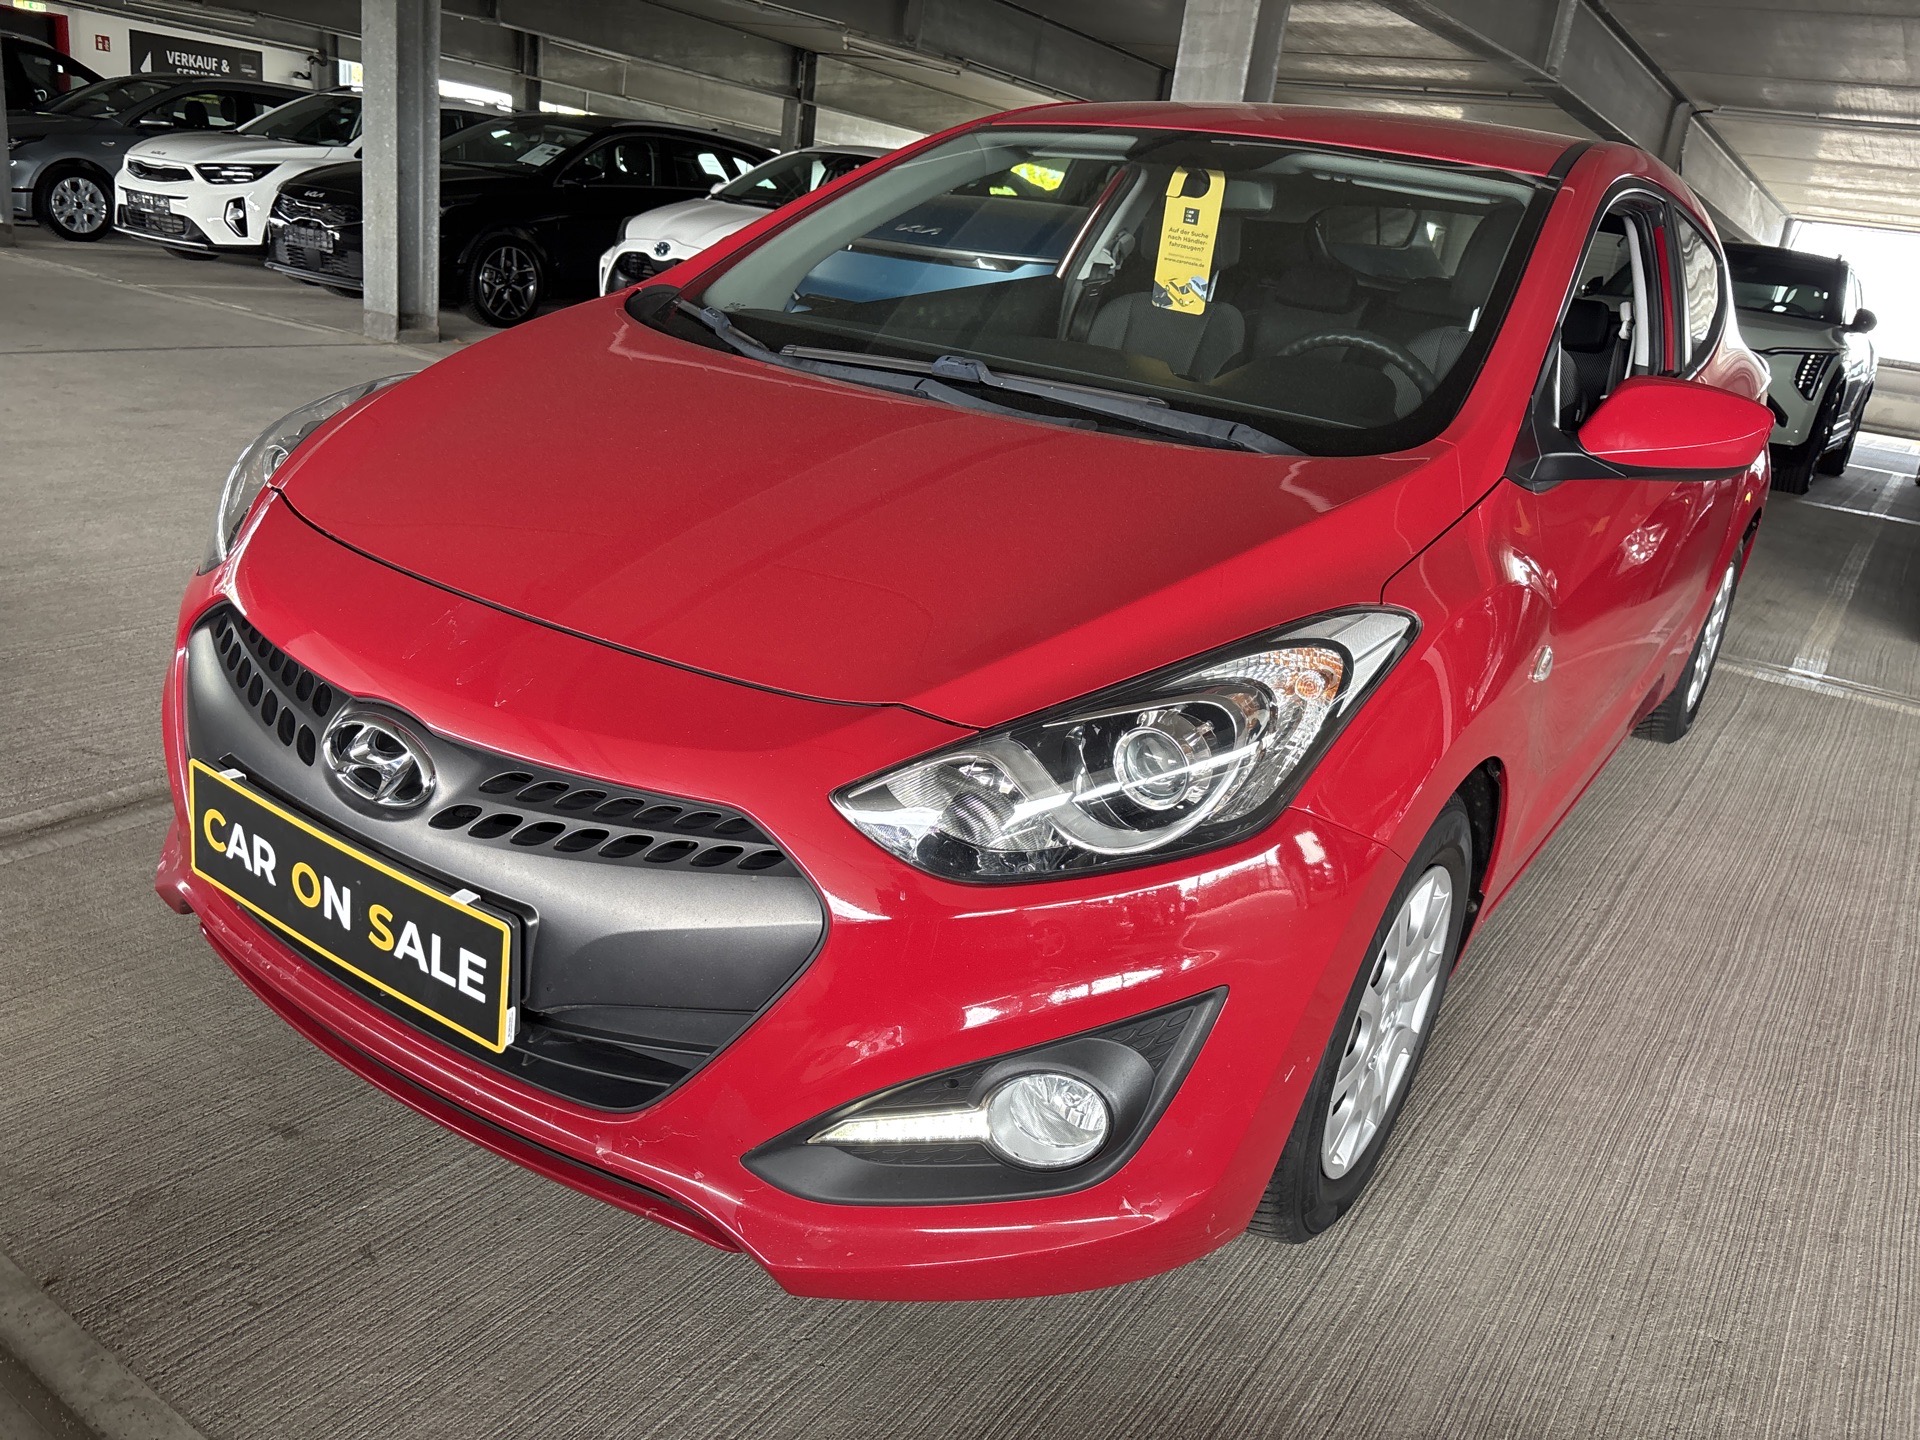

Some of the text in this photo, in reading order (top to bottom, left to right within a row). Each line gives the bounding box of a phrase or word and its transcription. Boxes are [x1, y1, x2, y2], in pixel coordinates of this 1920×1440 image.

[166, 50, 218, 71] VERKAUF
[221, 59, 230, 73] &
[1191, 231, 1209, 239] Suche
[1169, 241, 1205, 252] fahrzeugen?
[203, 808, 488, 1004] CAR ON SALE
